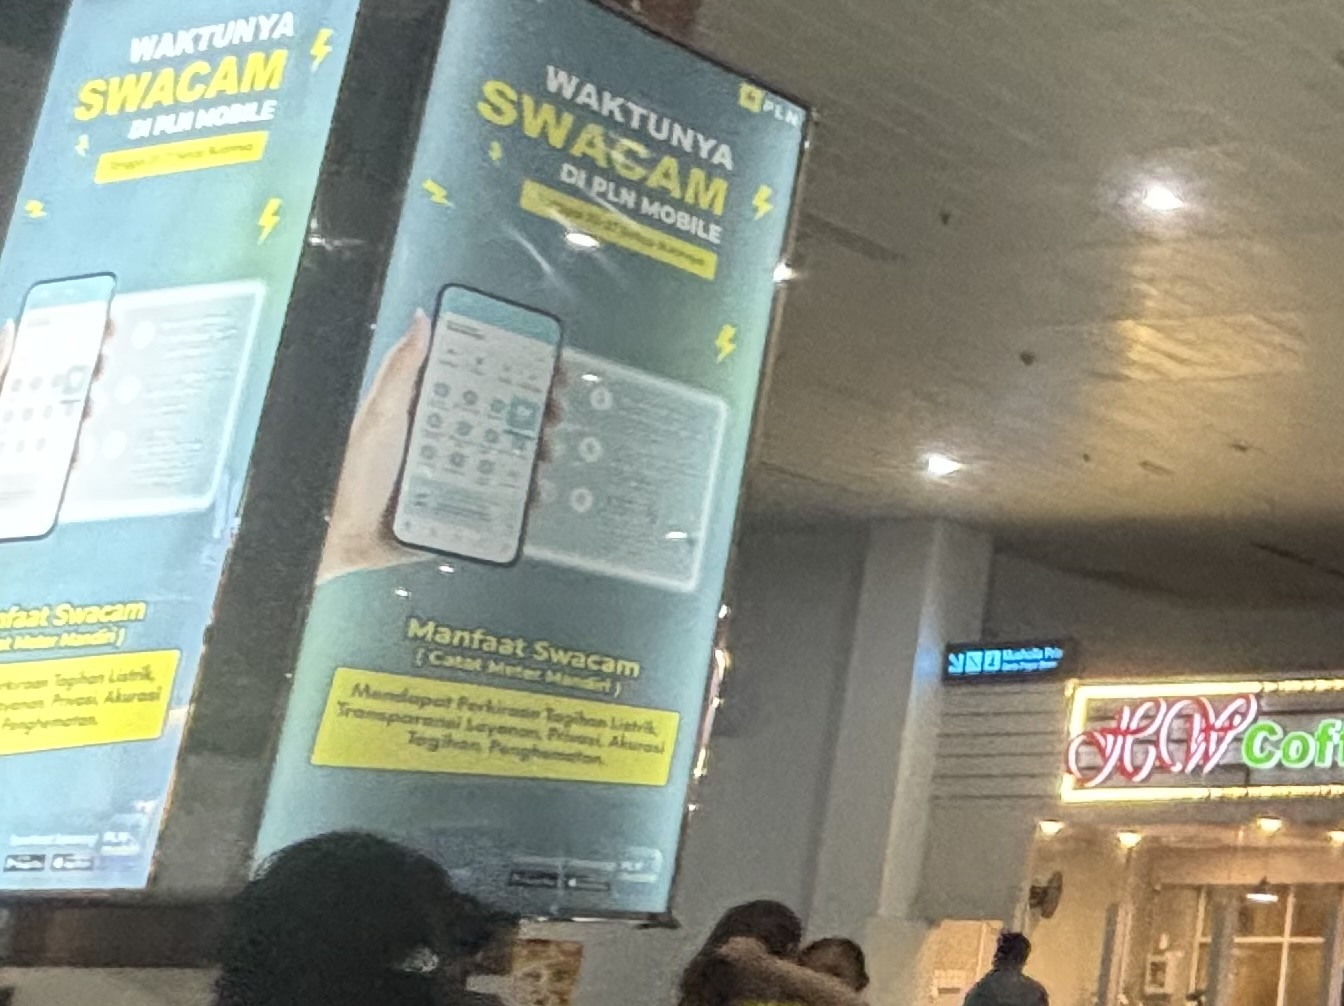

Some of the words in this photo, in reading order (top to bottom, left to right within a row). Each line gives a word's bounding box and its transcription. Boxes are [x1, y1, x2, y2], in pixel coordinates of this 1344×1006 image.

[130, 11, 294, 63] WAKTUNYA
[74, 49, 288, 121] SWACAM
[195, 100, 277, 130] MOBILE
[762, 100, 799, 127] PLN
[477, 79, 728, 216] SWACAM
[546, 65, 734, 171] WAKTUNYA
[559, 163, 587, 189] DI
[591, 176, 636, 209] PLN
[641, 197, 722, 244] MOBILE
[53, 602, 146, 627] Swacam
[407, 617, 527, 657] Manfaat
[532, 639, 640, 678] Swacam
